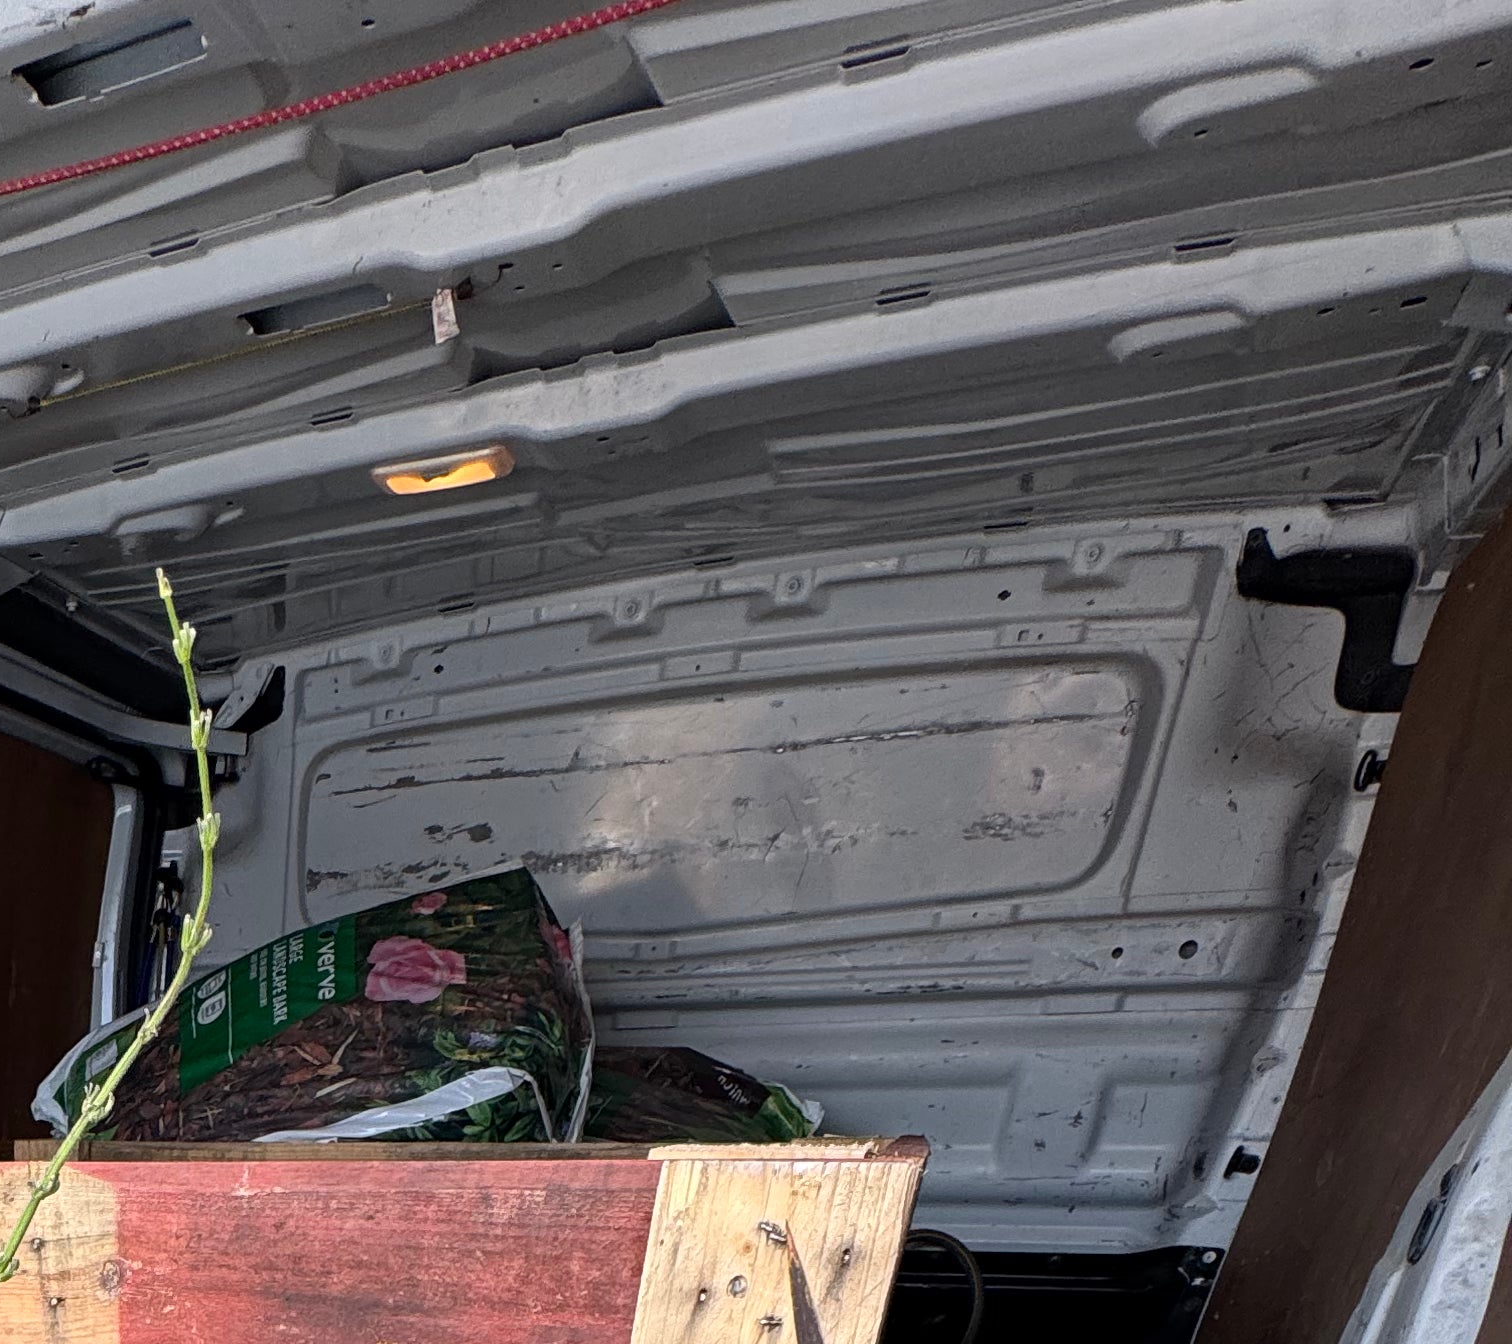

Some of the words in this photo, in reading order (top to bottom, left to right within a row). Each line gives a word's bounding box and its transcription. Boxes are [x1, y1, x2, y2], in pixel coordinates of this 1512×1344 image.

[272, 940, 288, 995] LANDSCAPE
[289, 933, 304, 966] LARGE
[317, 941, 336, 1000] verve
[273, 994, 288, 1025] BARK
